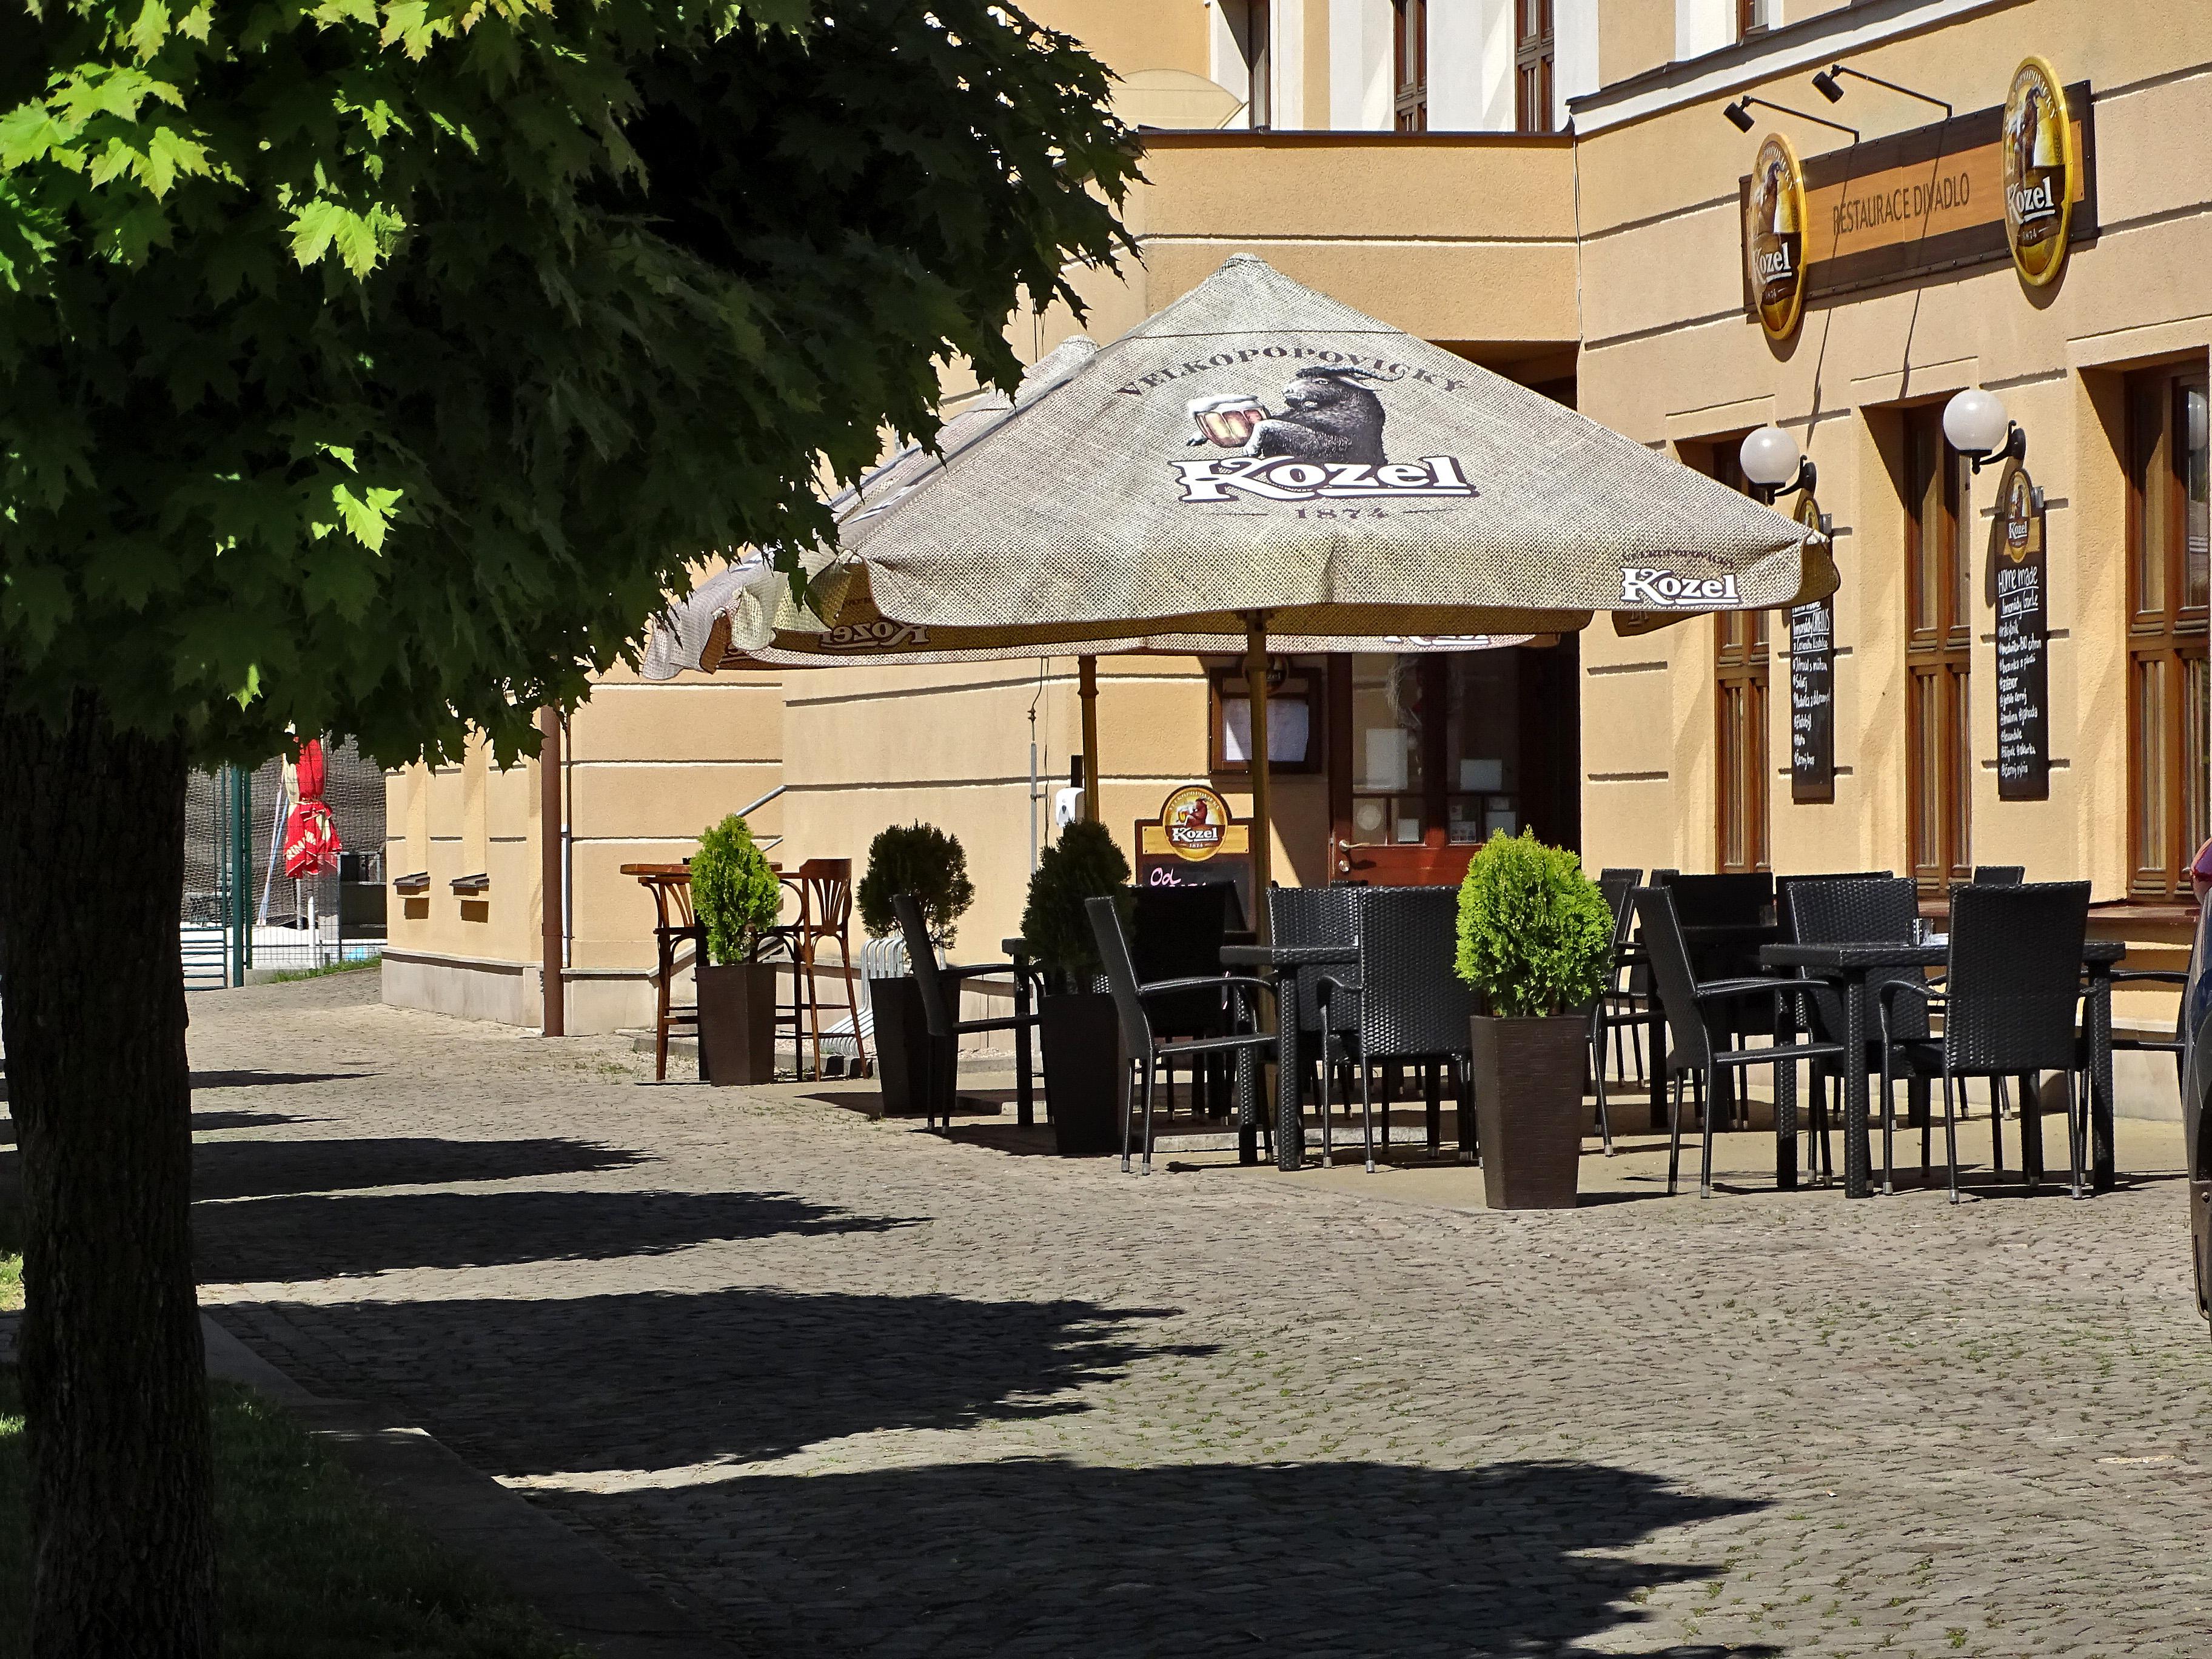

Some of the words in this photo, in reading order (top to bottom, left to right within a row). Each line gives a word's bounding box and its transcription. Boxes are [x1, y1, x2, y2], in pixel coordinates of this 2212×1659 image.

[1833, 187, 1911, 236] RESTAURACE
[1914, 172, 1969, 216] DIVADLO
[2006, 176, 2056, 225] Kozel
[1754, 242, 1792, 284] Kozel
[1170, 455, 1475, 501] Kozel
[1296, 508, 1389, 519] 1874
[2008, 521, 2028, 540] Kozel
[1620, 567, 1741, 605] Kozel
[1172, 827, 1218, 842] Kozel
[1150, 867, 1181, 886] Od
